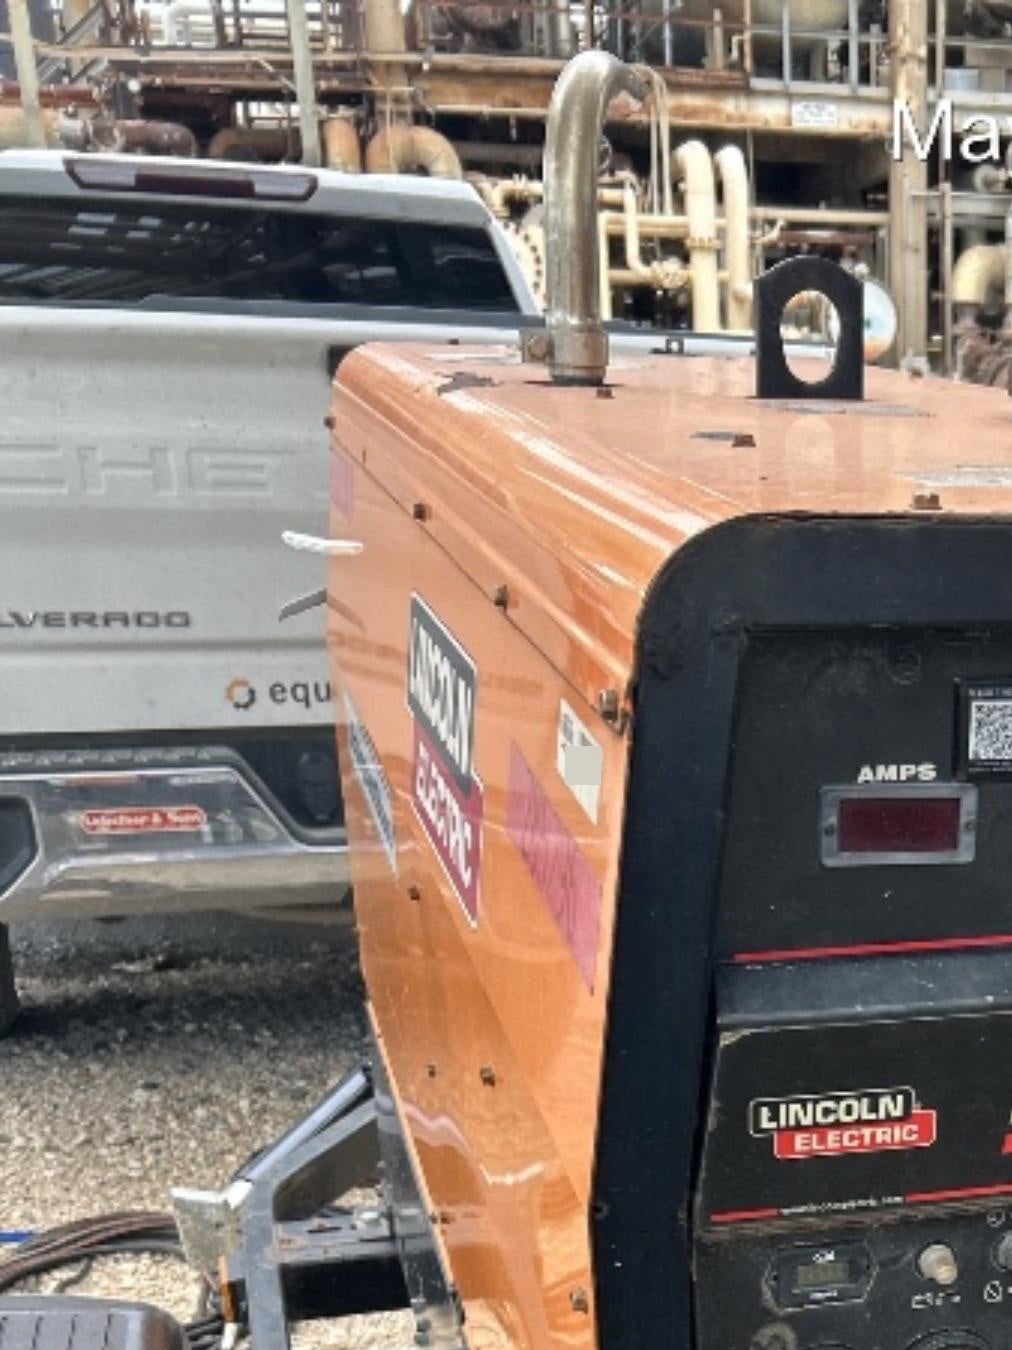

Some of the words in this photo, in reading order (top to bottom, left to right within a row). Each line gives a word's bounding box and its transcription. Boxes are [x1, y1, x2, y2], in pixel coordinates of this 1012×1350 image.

[410, 617, 474, 776] LINCOLN
[857, 762, 937, 784] AMPS
[760, 1094, 905, 1129] LINCOLN
[794, 1124, 919, 1151] ELECTRIC
